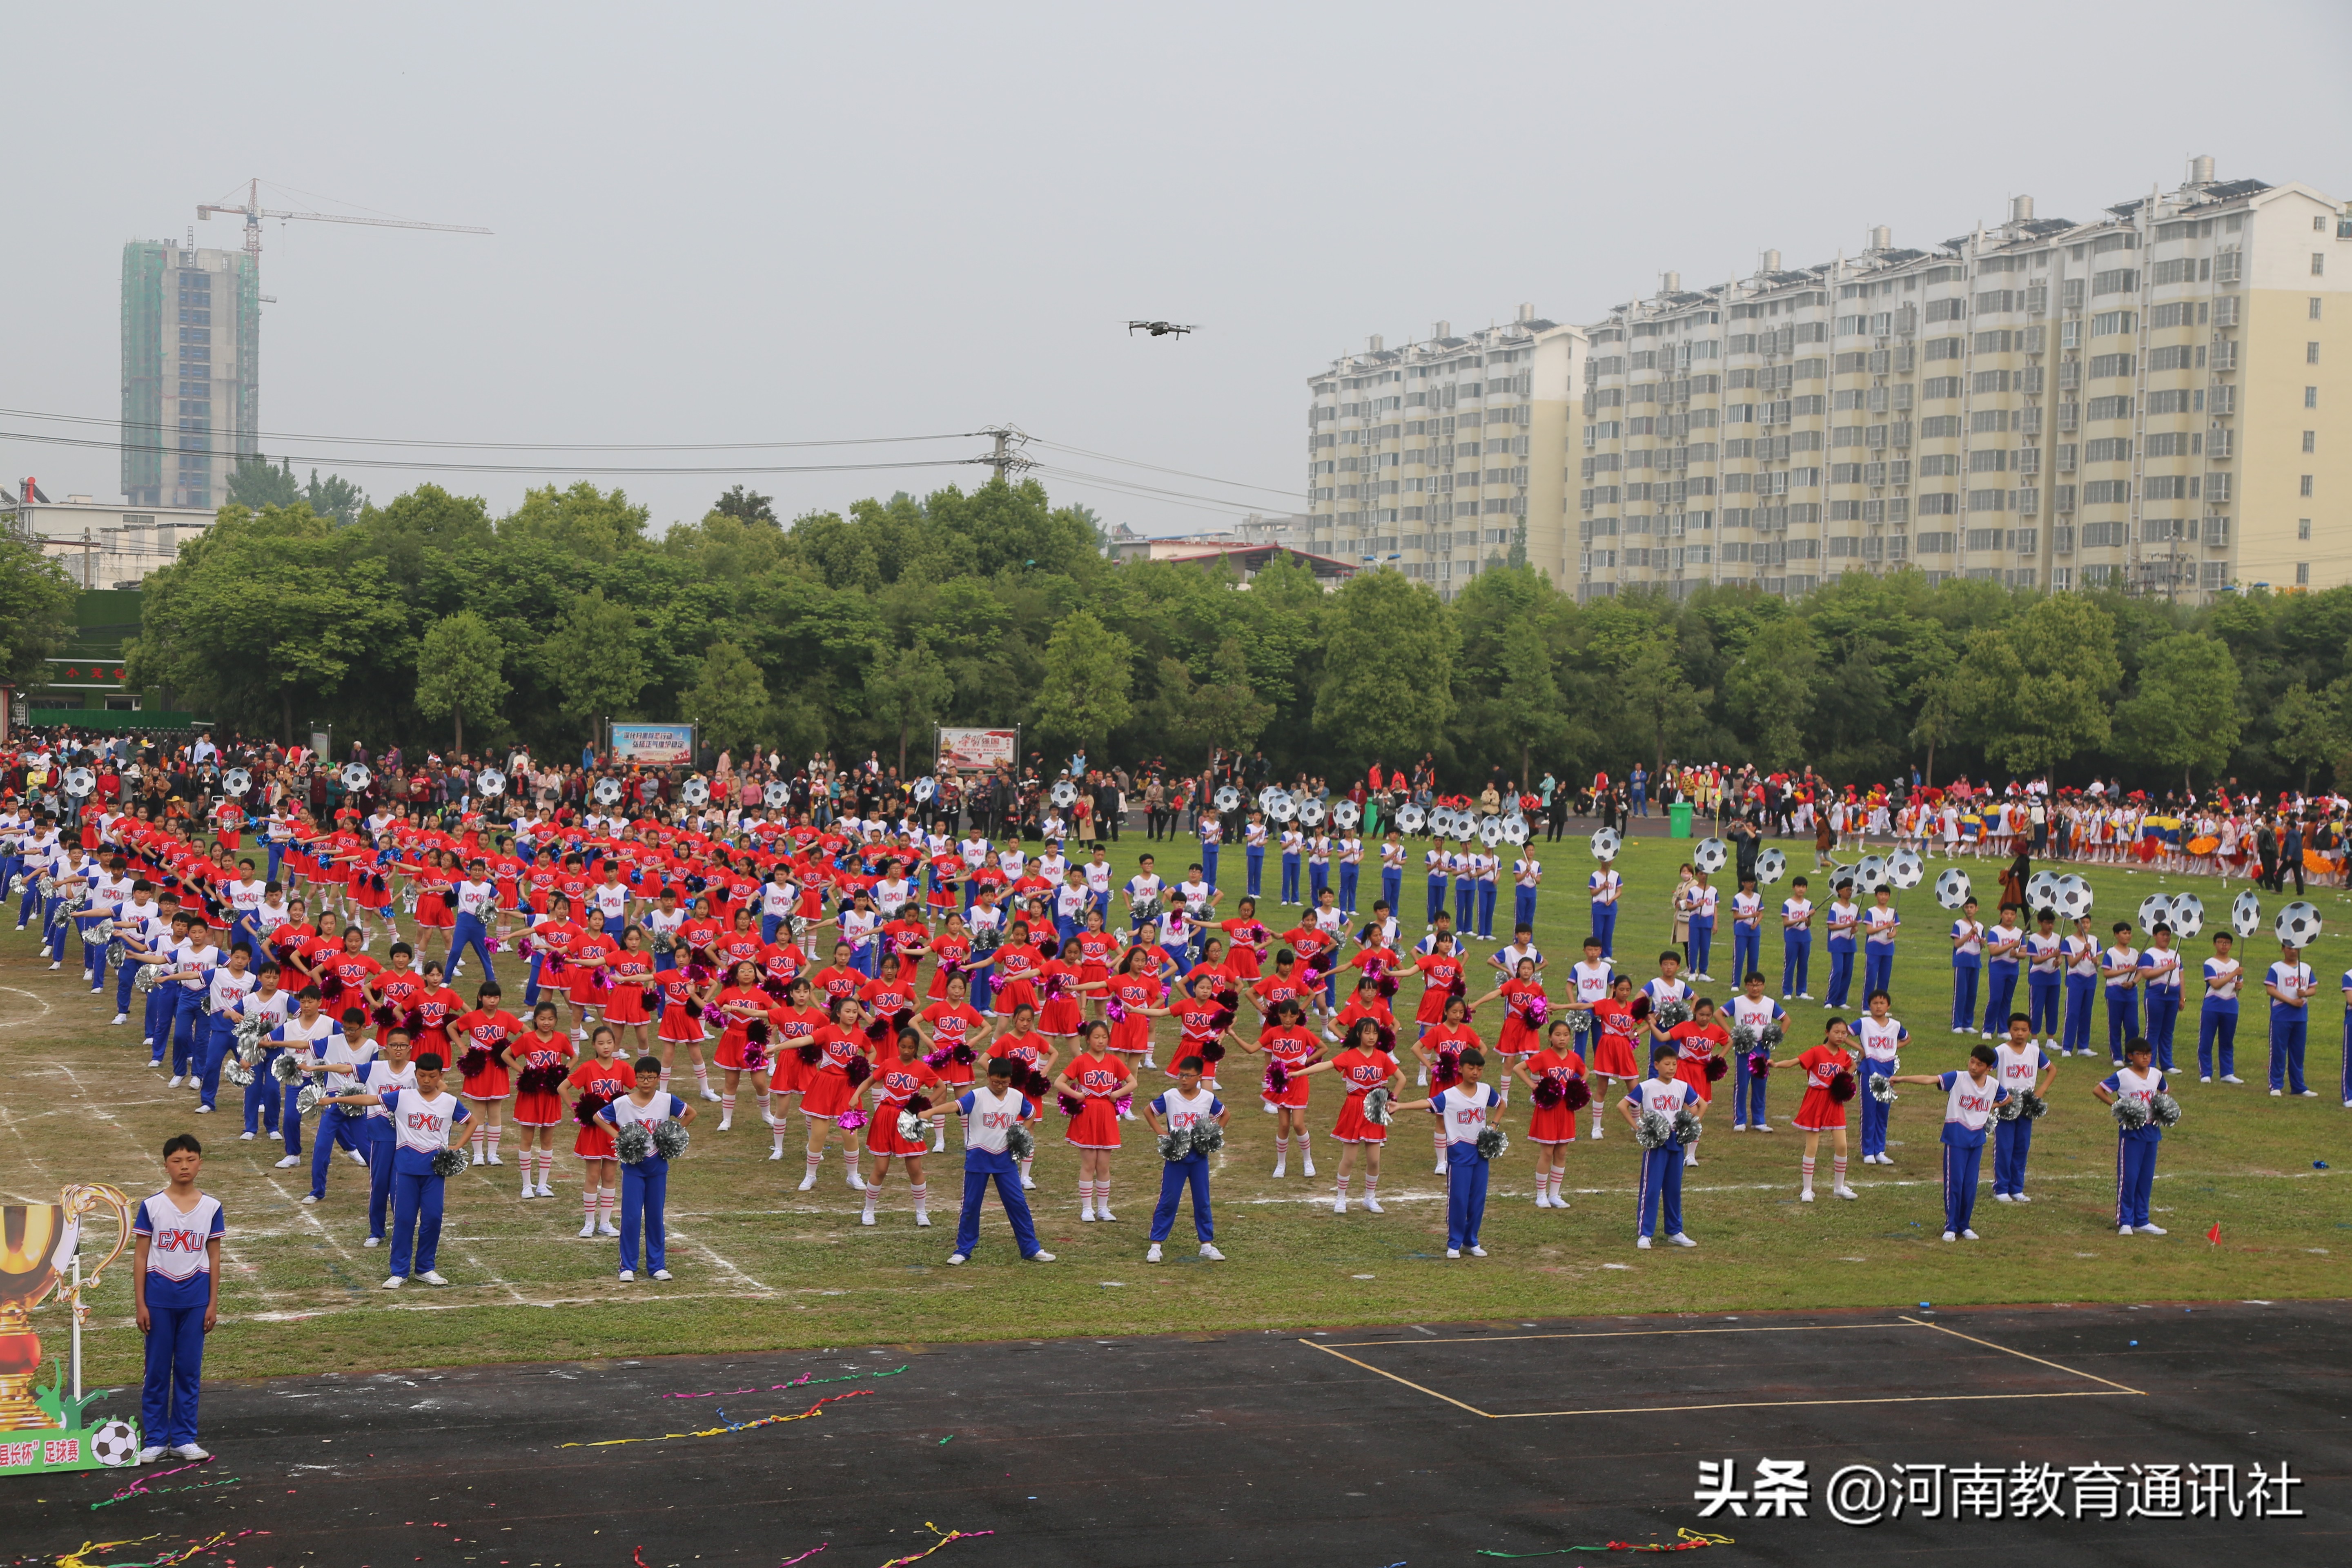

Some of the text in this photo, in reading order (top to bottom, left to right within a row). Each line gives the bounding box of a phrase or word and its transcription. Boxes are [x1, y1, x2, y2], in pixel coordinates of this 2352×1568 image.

[66, 667, 126, 679] 小笼包
[959, 733, 999, 746] 学习强国
[538, 831, 554, 839] CXU
[567, 834, 585, 843] CXU
[763, 831, 779, 839] CXU
[314, 842, 332, 850] CXU
[339, 837, 356, 846] CXU
[827, 841, 843, 849] CXU
[644, 855, 661, 864] CXU
[498, 863, 516, 873] CXU
[940, 862, 957, 871] CXU
[1045, 866, 1062, 875] CXU
[533, 874, 553, 883] CXU
[804, 873, 822, 882] CXU
[981, 877, 999, 886] CXU
[1092, 874, 1109, 883] CXU
[565, 882, 584, 892] CXU
[732, 884, 752, 894] CXU
[846, 883, 864, 892] CXU
[1140, 887, 1155, 896] CXU
[102, 889, 125, 899] CXU
[236, 893, 258, 902] CXU
[465, 893, 486, 902] CXU
[884, 893, 904, 902] CXU
[1187, 893, 1205, 902] CXU
[602, 898, 621, 907] CXU
[1065, 898, 1084, 906] CXU
[548, 931, 571, 944] CXU
[690, 929, 713, 941] CXU
[898, 931, 919, 942] CXU
[731, 943, 755, 954] CXU
[1083, 942, 1105, 953] CXU
[1297, 940, 1319, 951] CXU
[582, 946, 606, 958] CXU
[944, 946, 962, 958] CXU
[769, 956, 794, 969] CXU
[1006, 955, 1029, 967] CXU
[339, 964, 366, 977] CXU
[621, 962, 646, 975] CXU
[1434, 965, 1455, 977] CXU
[387, 982, 414, 996] CXU
[829, 979, 854, 992] CXU
[1582, 979, 1604, 989] CXU
[1123, 986, 1147, 1000] CXU
[1272, 987, 1296, 1000] CXU
[876, 993, 902, 1007] CXU
[419, 1002, 446, 1016] CXU
[939, 1016, 967, 1031] CXU
[1185, 1012, 1212, 1027] CXU
[1744, 1013, 1768, 1025] CXU
[474, 1025, 505, 1040] CXU
[785, 1022, 814, 1036] CXU
[1273, 1038, 1302, 1053] CXU
[1686, 1036, 1714, 1051] CXU
[1868, 1036, 1894, 1049] CXU
[830, 1041, 858, 1057] CXU
[530, 1050, 561, 1066] CXU
[1353, 1065, 1383, 1081] CXU
[2006, 1063, 2034, 1078] CXU
[886, 1072, 918, 1090] CXU
[1084, 1070, 1114, 1086] CXU
[590, 1078, 622, 1095] CXU
[1652, 1095, 1681, 1111] CXU
[1959, 1095, 1990, 1112] CXU
[408, 1112, 443, 1131] CXU
[983, 1112, 1014, 1129] CXU
[157, 1228, 204, 1253] CXU
[44, 1439, 78, 1463] 足球赛
